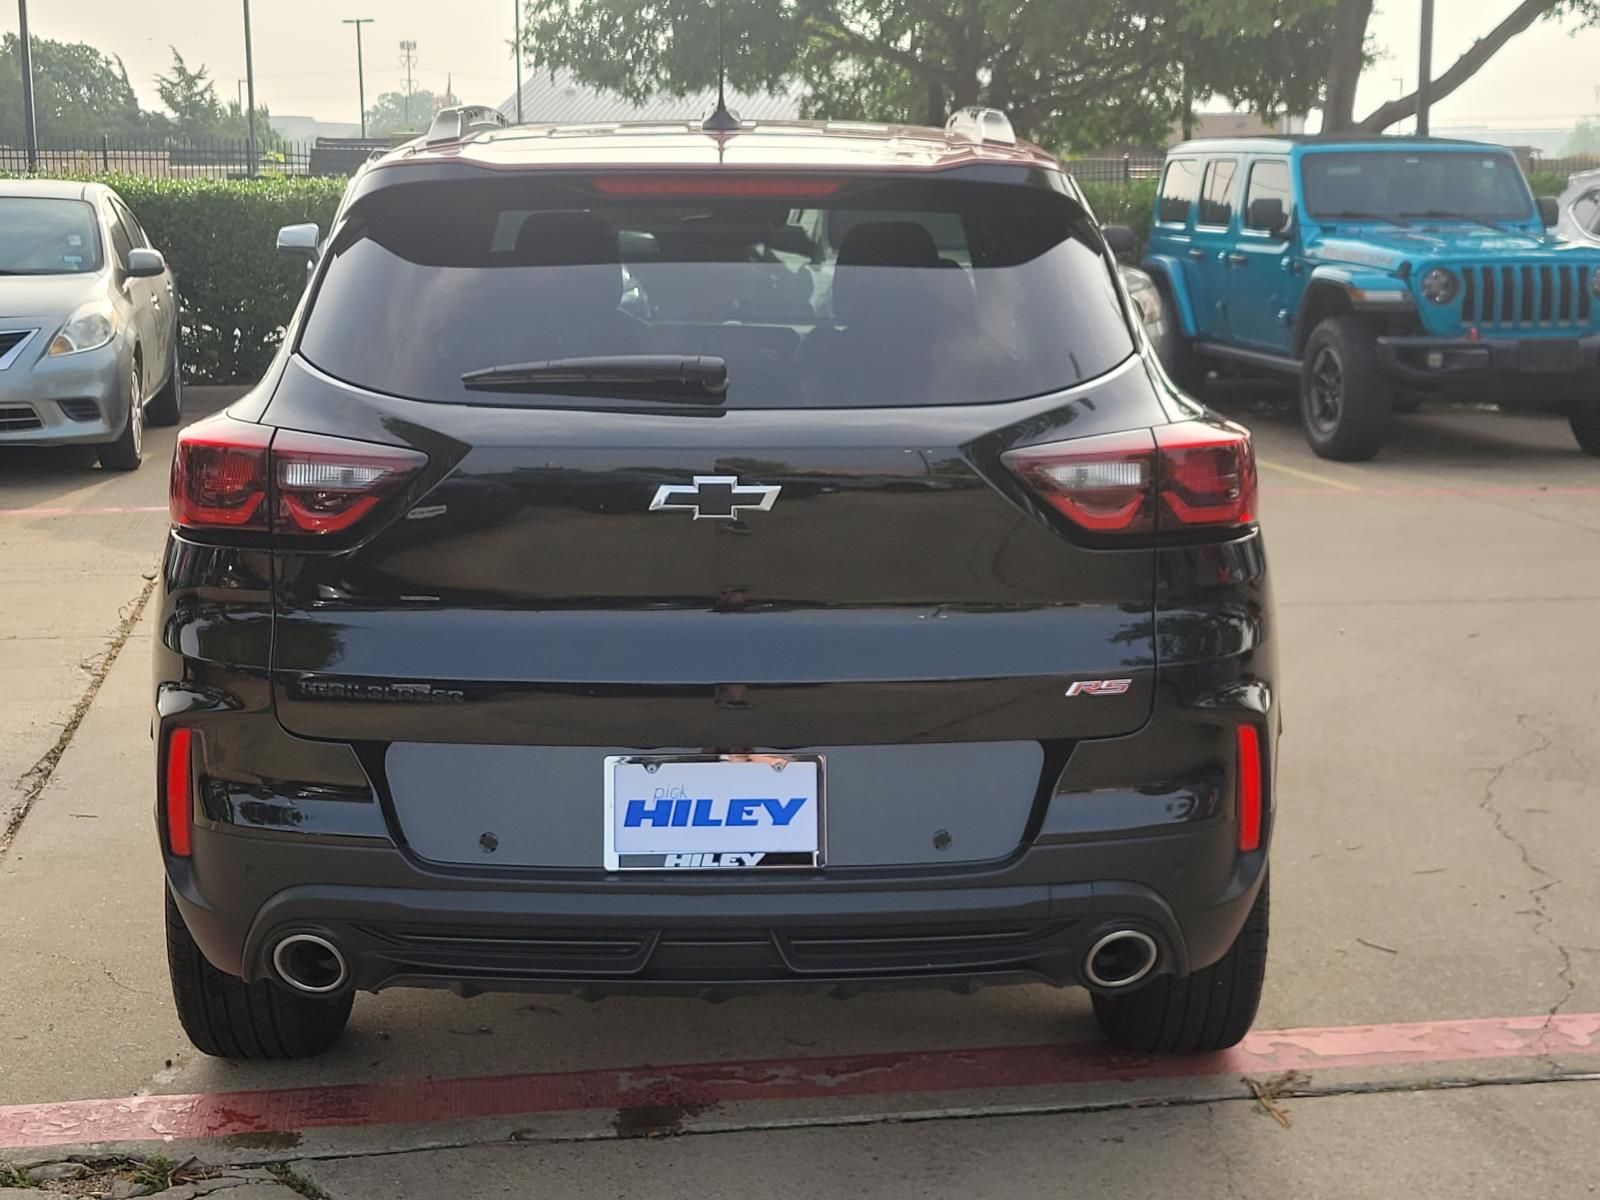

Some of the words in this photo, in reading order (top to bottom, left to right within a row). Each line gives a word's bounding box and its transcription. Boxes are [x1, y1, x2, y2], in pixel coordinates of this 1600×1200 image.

[1065, 679, 1132, 696] RS
[653, 784, 688, 801] pick
[624, 798, 807, 828] HILEY
[664, 853, 766, 868] HILEY
